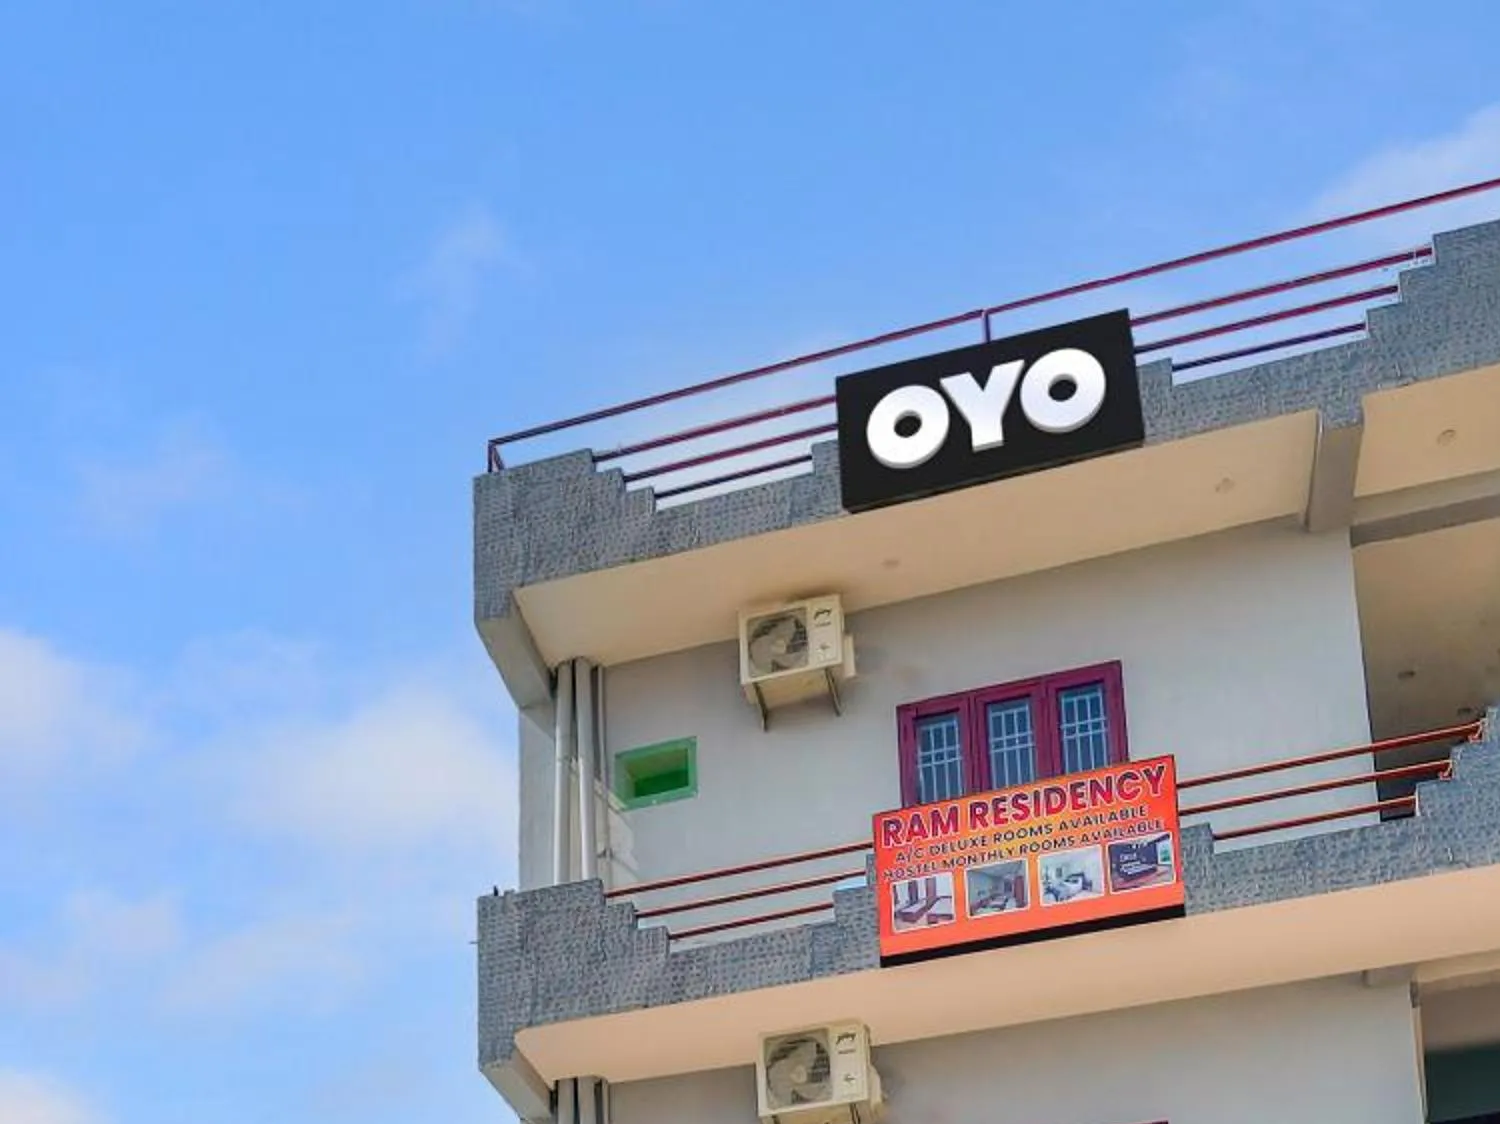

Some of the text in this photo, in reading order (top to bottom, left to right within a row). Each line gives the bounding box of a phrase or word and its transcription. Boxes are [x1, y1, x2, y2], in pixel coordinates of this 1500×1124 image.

[866, 348, 1106, 469] OYO
[882, 764, 1166, 849] RAM RESIDENCY
[930, 835, 989, 856] DELUXE
[993, 823, 1053, 845] ROOMS
[1059, 804, 1148, 831] AVAILABLE
[943, 846, 1016, 869] MONTHLY
[1019, 835, 1076, 855] ROOMS
[1080, 819, 1164, 845] AVAILABLE
